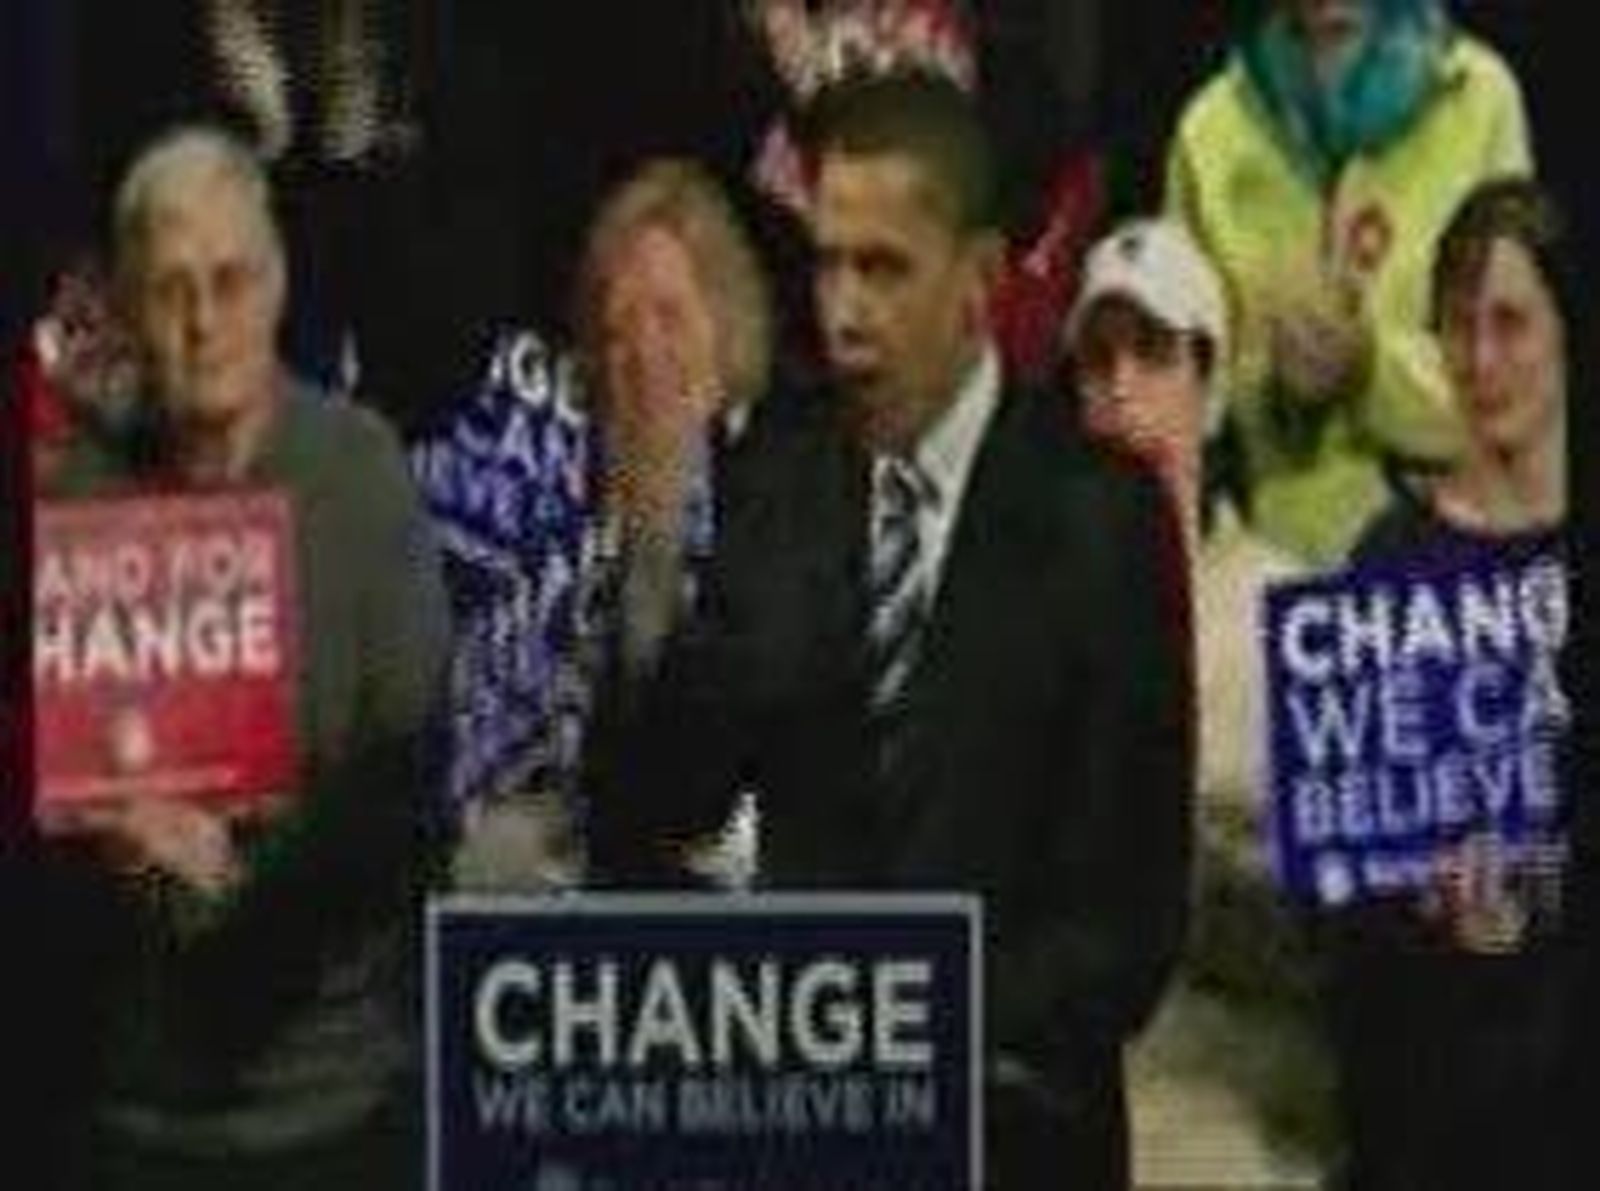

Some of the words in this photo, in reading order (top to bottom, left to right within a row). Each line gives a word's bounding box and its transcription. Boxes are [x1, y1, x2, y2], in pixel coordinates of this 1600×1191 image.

[34, 594, 281, 686] HANGE
[1286, 668, 1430, 768] WE
[473, 958, 936, 1067] CHANGE
[475, 1076, 546, 1132] WE
[562, 1076, 667, 1132] CAN
[677, 1076, 875, 1132] BELIEVE
[886, 1076, 936, 1130] IN
